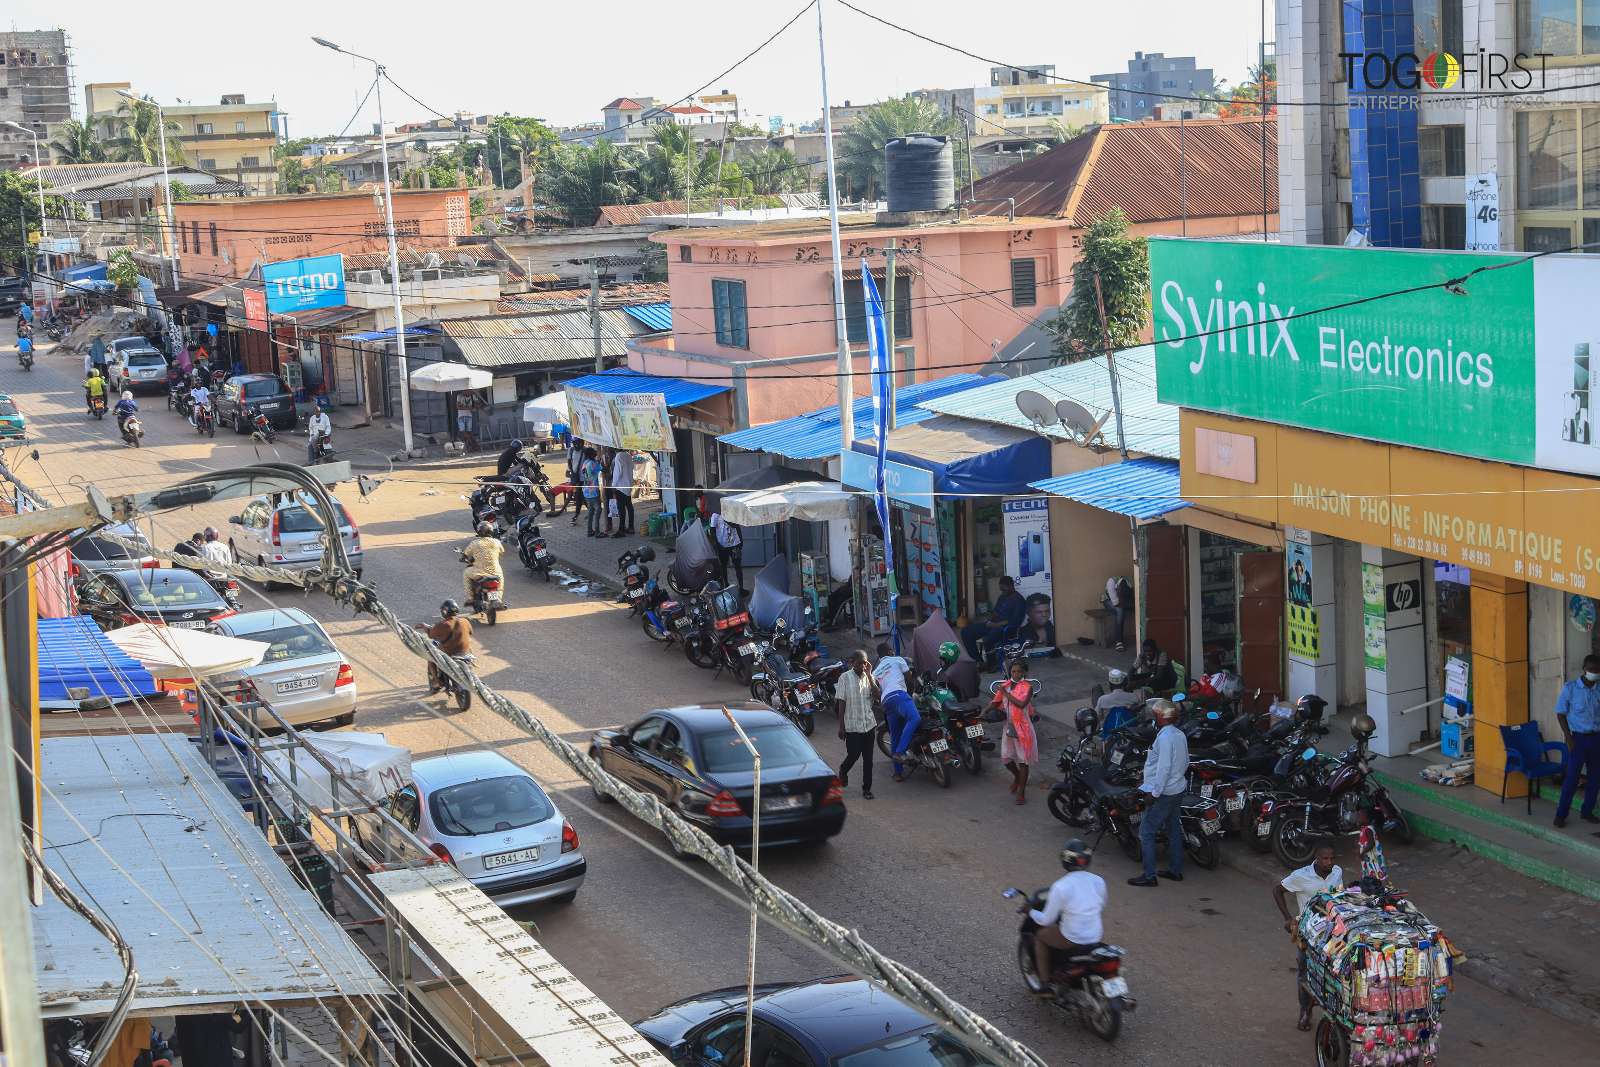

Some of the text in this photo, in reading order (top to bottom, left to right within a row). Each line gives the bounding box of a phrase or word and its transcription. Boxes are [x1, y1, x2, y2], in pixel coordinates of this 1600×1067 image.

[1477, 205, 1497, 223] 4G
[272, 272, 338, 297] TECNO
[1160, 279, 1494, 388] Syinix Electronics
[1293, 482, 1351, 517] MAISON
[1359, 496, 1411, 531] PHONE
[1423, 510, 1563, 564] INFORMATIQUE
[1396, 582, 1411, 610] hp
[495, 848, 536, 866] 5841 AL
